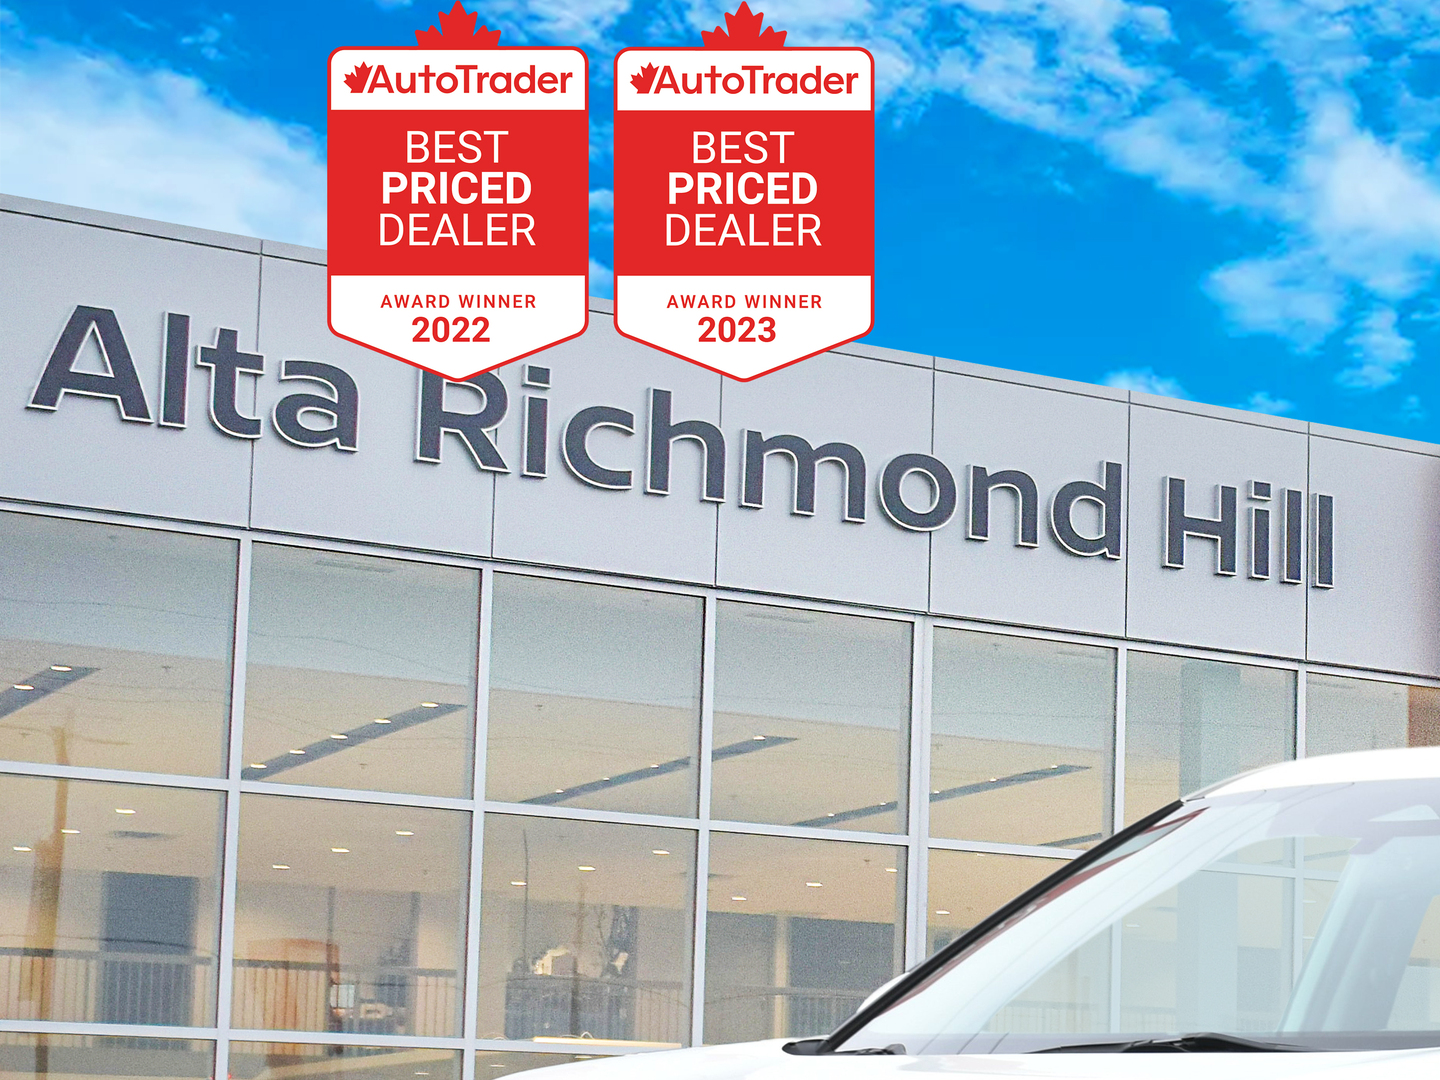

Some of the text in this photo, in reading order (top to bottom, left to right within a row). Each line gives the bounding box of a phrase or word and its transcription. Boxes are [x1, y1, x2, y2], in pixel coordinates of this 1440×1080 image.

[26, 304, 1335, 589] Alta Richmond Hill
